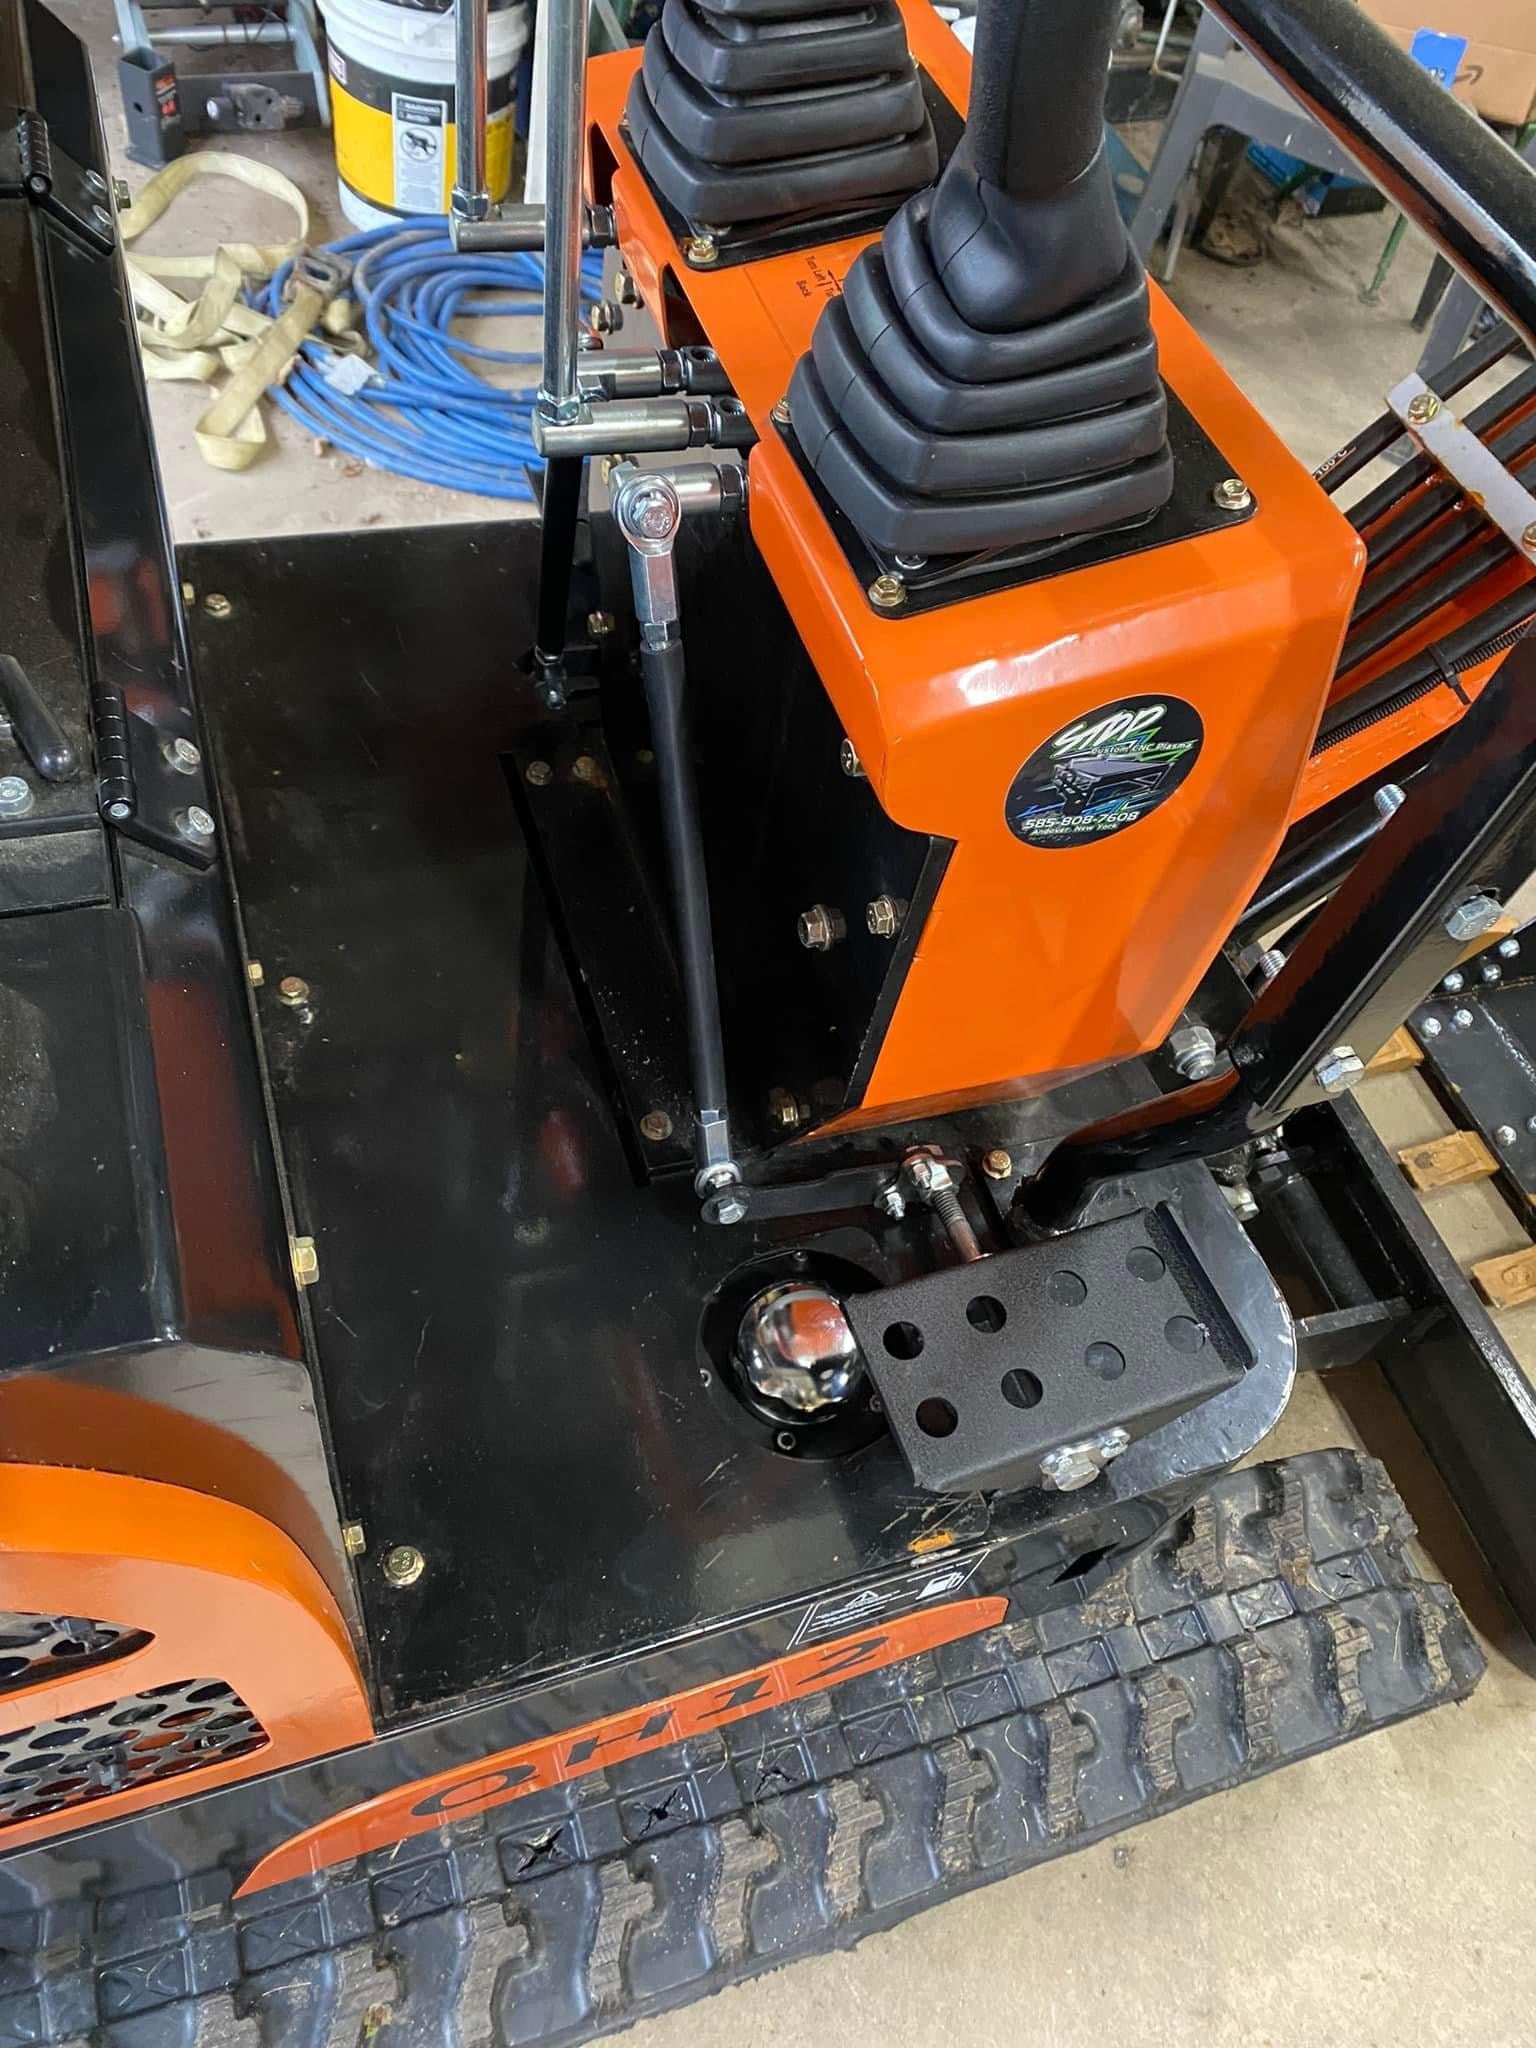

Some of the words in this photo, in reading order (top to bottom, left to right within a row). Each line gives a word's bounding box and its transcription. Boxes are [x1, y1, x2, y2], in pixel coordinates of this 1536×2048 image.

[1091, 743, 1129, 754] Custom
[1132, 743, 1155, 752] CNC
[1155, 739, 1193, 751] Plasma
[1022, 811, 1140, 830] 585-808-7608
[1073, 824, 1095, 833] New
[1095, 822, 1118, 832] York
